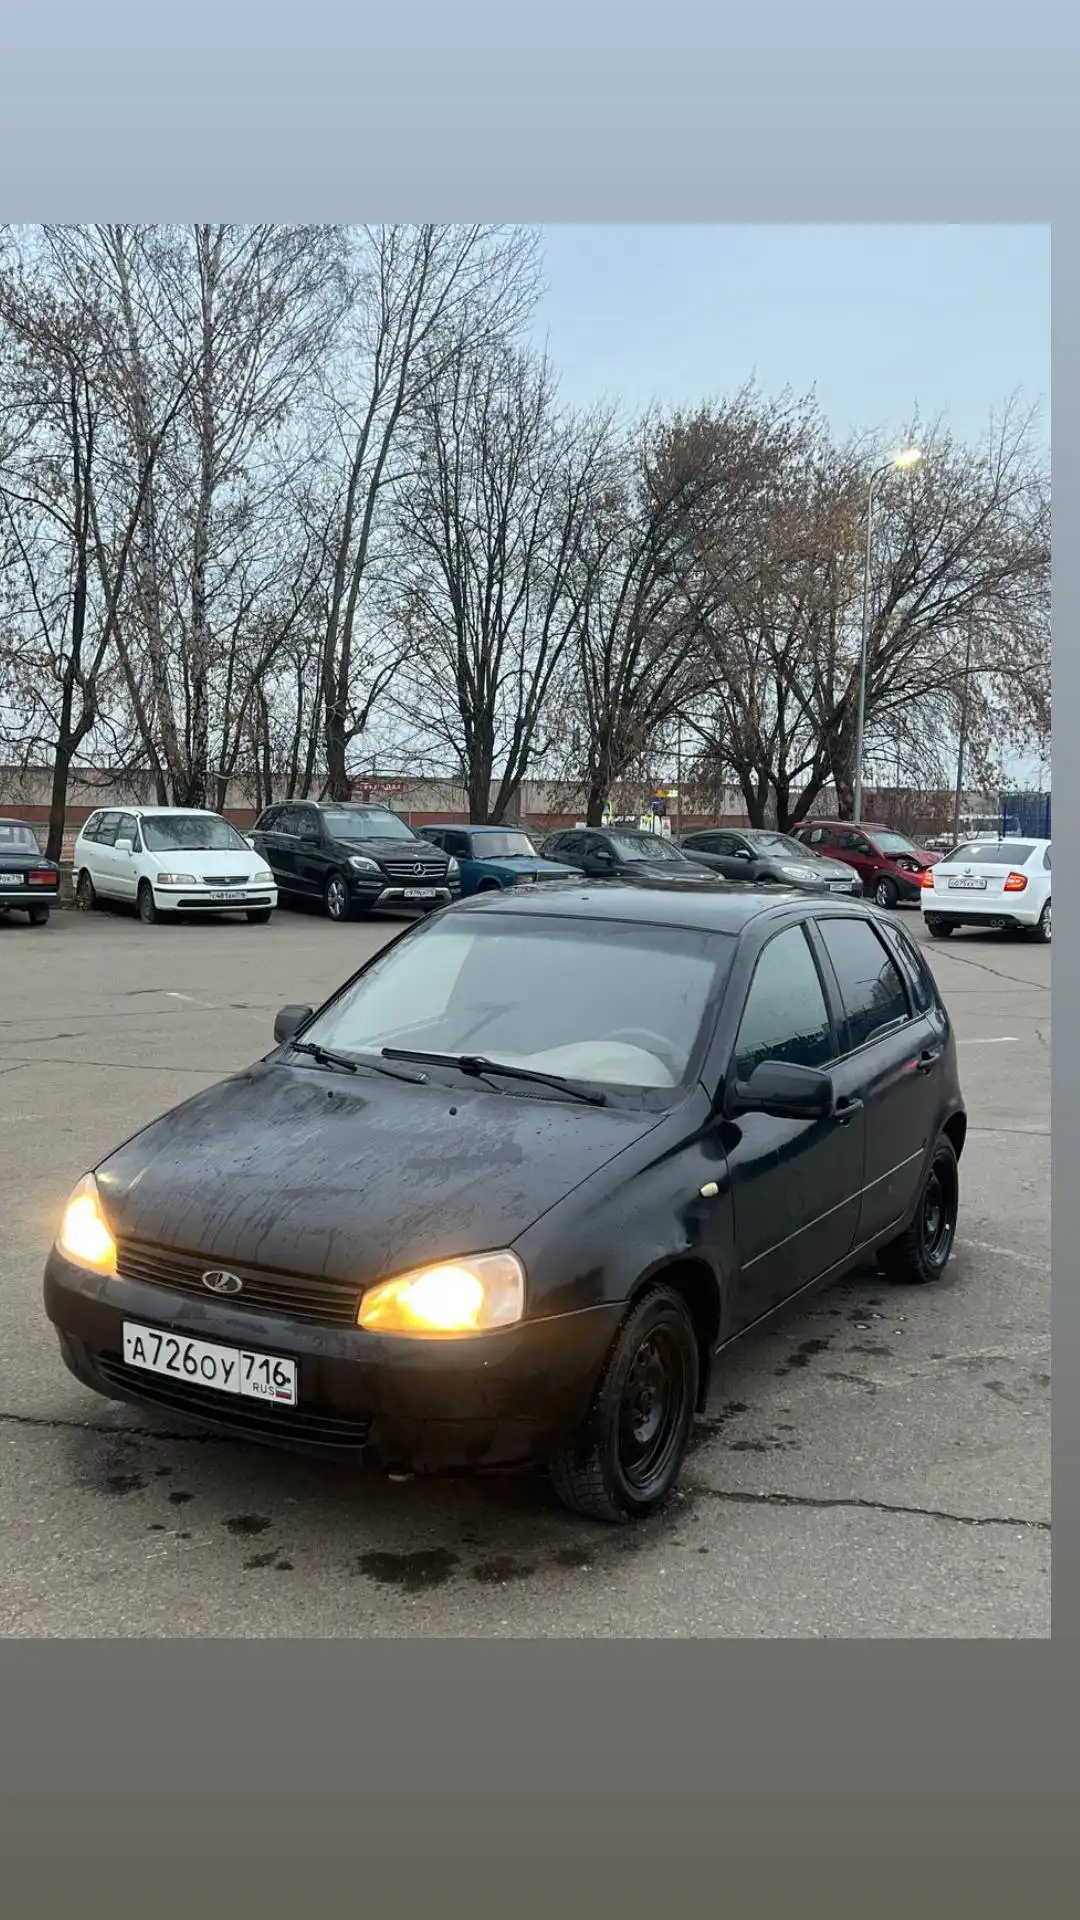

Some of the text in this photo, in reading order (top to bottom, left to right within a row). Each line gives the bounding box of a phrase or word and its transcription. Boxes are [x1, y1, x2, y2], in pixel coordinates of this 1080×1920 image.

[132, 1332, 287, 1387] А726ОУ 716
[252, 1382, 275, 1396] RUS
